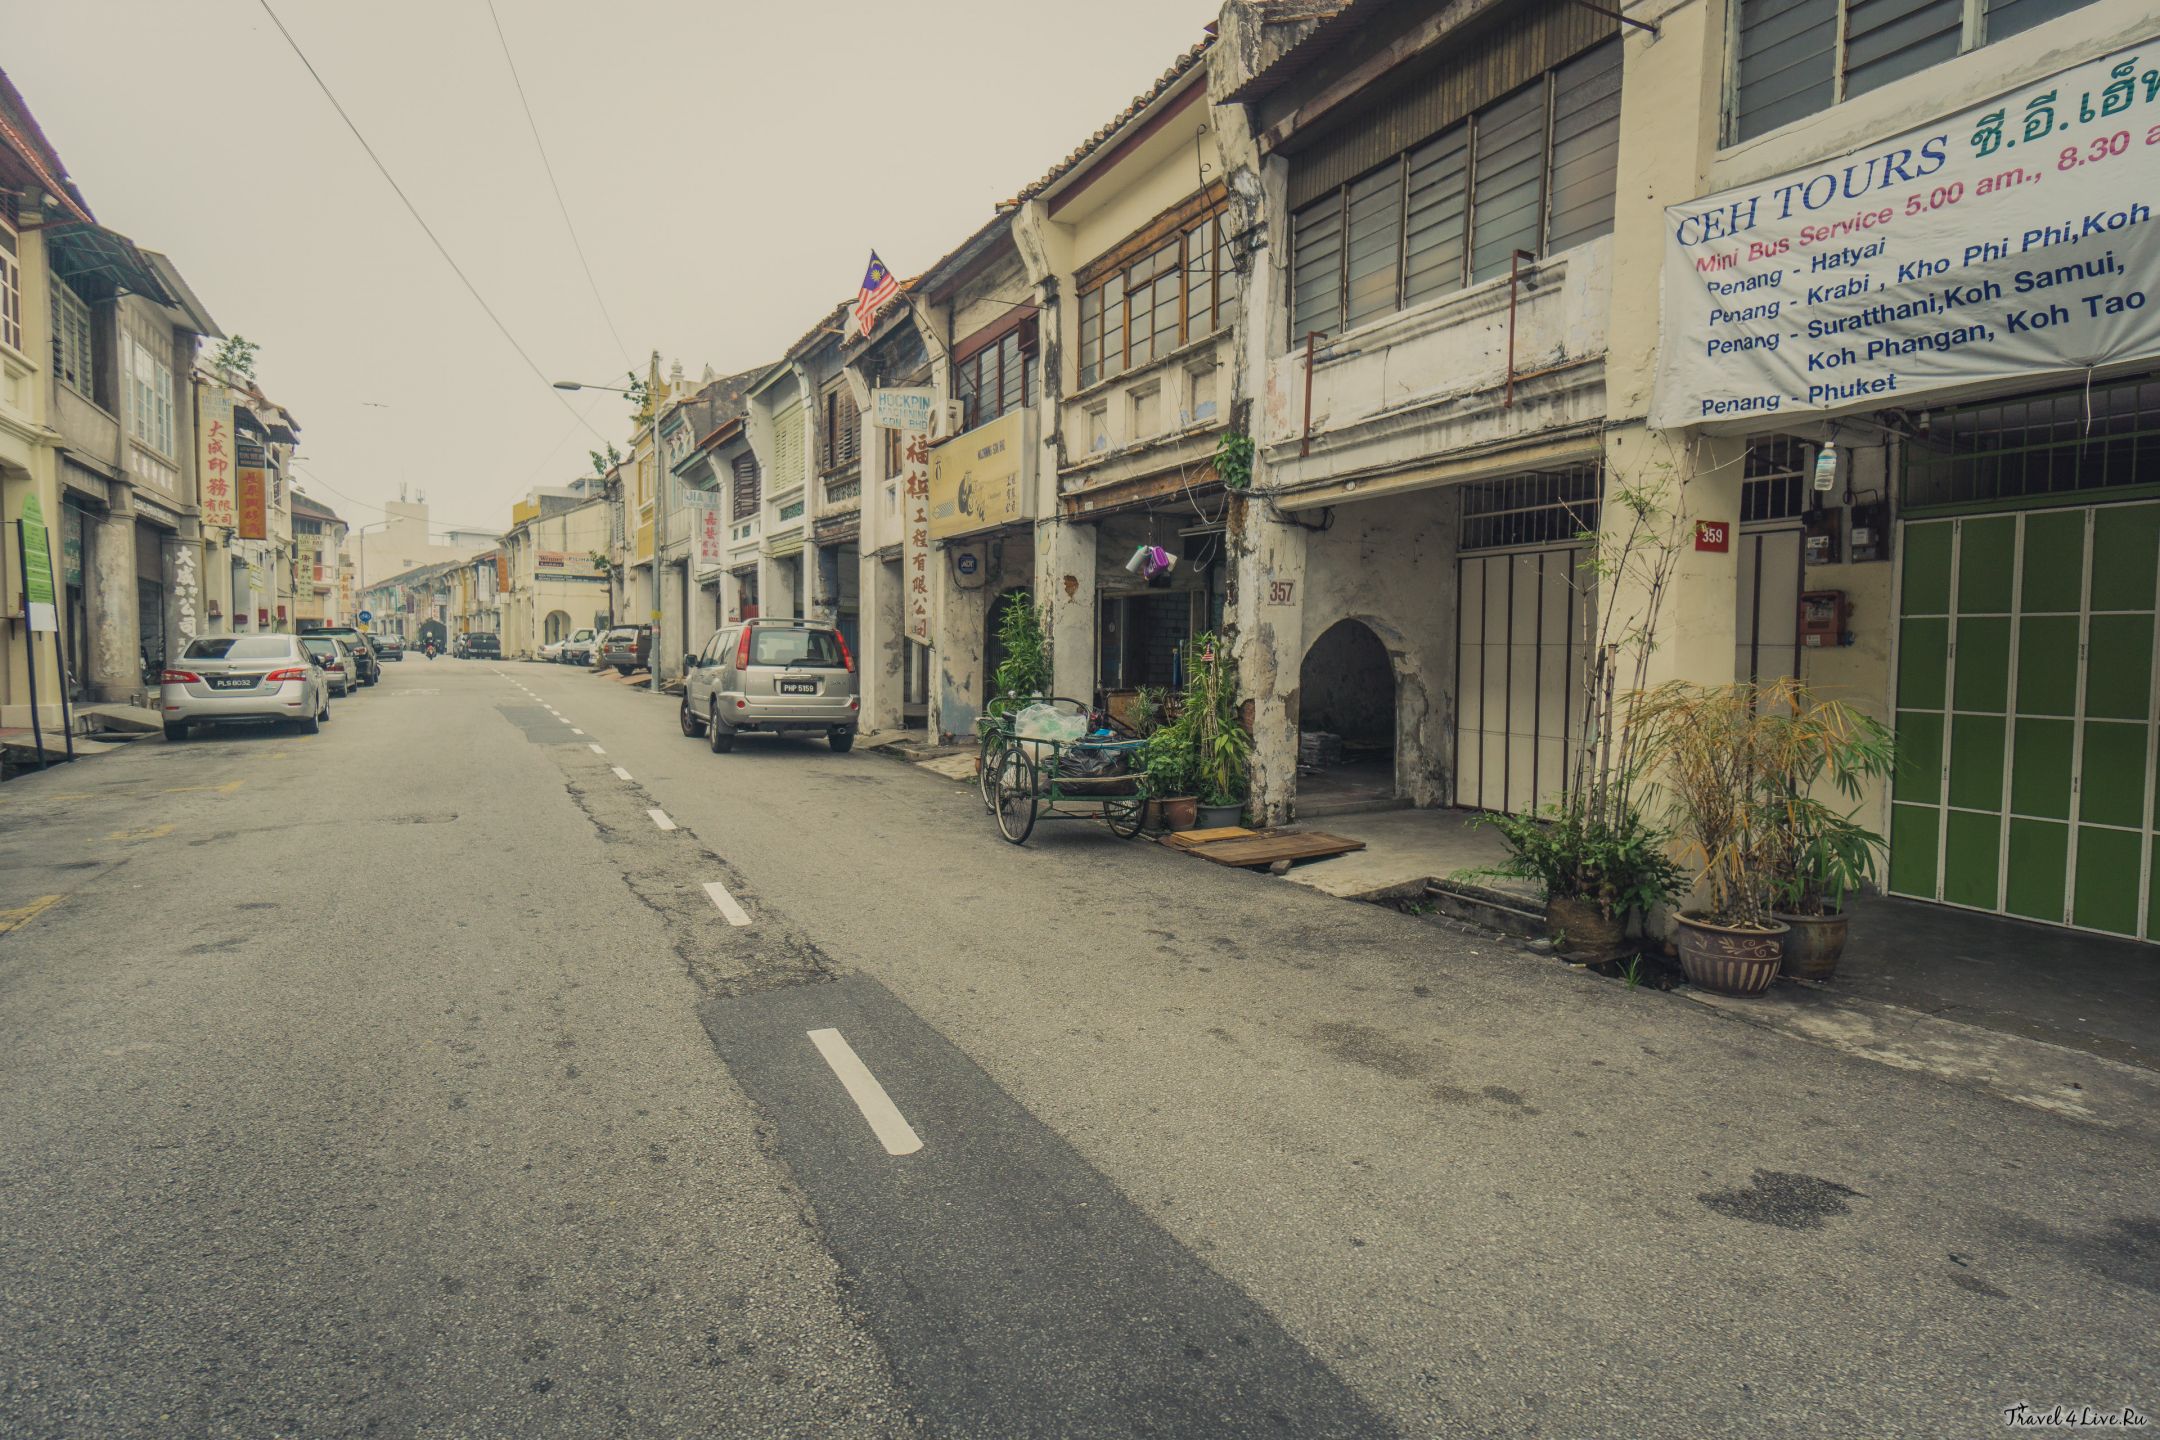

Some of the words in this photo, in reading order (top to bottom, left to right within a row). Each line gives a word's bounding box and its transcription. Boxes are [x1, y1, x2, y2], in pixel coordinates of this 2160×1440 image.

[1676, 196, 1761, 246] CEH
[1774, 134, 1948, 220] TOURS
[1696, 248, 1737, 273] Mini
[1747, 237, 1790, 262] Bus
[1800, 205, 1893, 246] Service
[1905, 182, 1964, 216] 5.00
[2057, 131, 2130, 170] 8.30
[1708, 269, 1783, 296] Penang
[1811, 237, 1886, 273] Hatyai
[1709, 301, 1780, 326] Penang
[1807, 274, 1870, 305] Krabi
[1897, 258, 1950, 283] Kho
[1963, 238, 2009, 267] Phi
[1707, 333, 1780, 357] Penang
[2014, 251, 2125, 293] Samui,
[1808, 347, 1856, 371] Koh
[1868, 323, 1995, 361] Phangan,
[2007, 304, 2070, 334] Koh
[2081, 291, 2146, 318] Tao
[1702, 395, 1781, 416] Penang
[1808, 373, 1897, 403] Phuket
[1702, 527, 1723, 543] 359
[1270, 581, 1294, 602] 357
[784, 684, 797, 692] PHP
